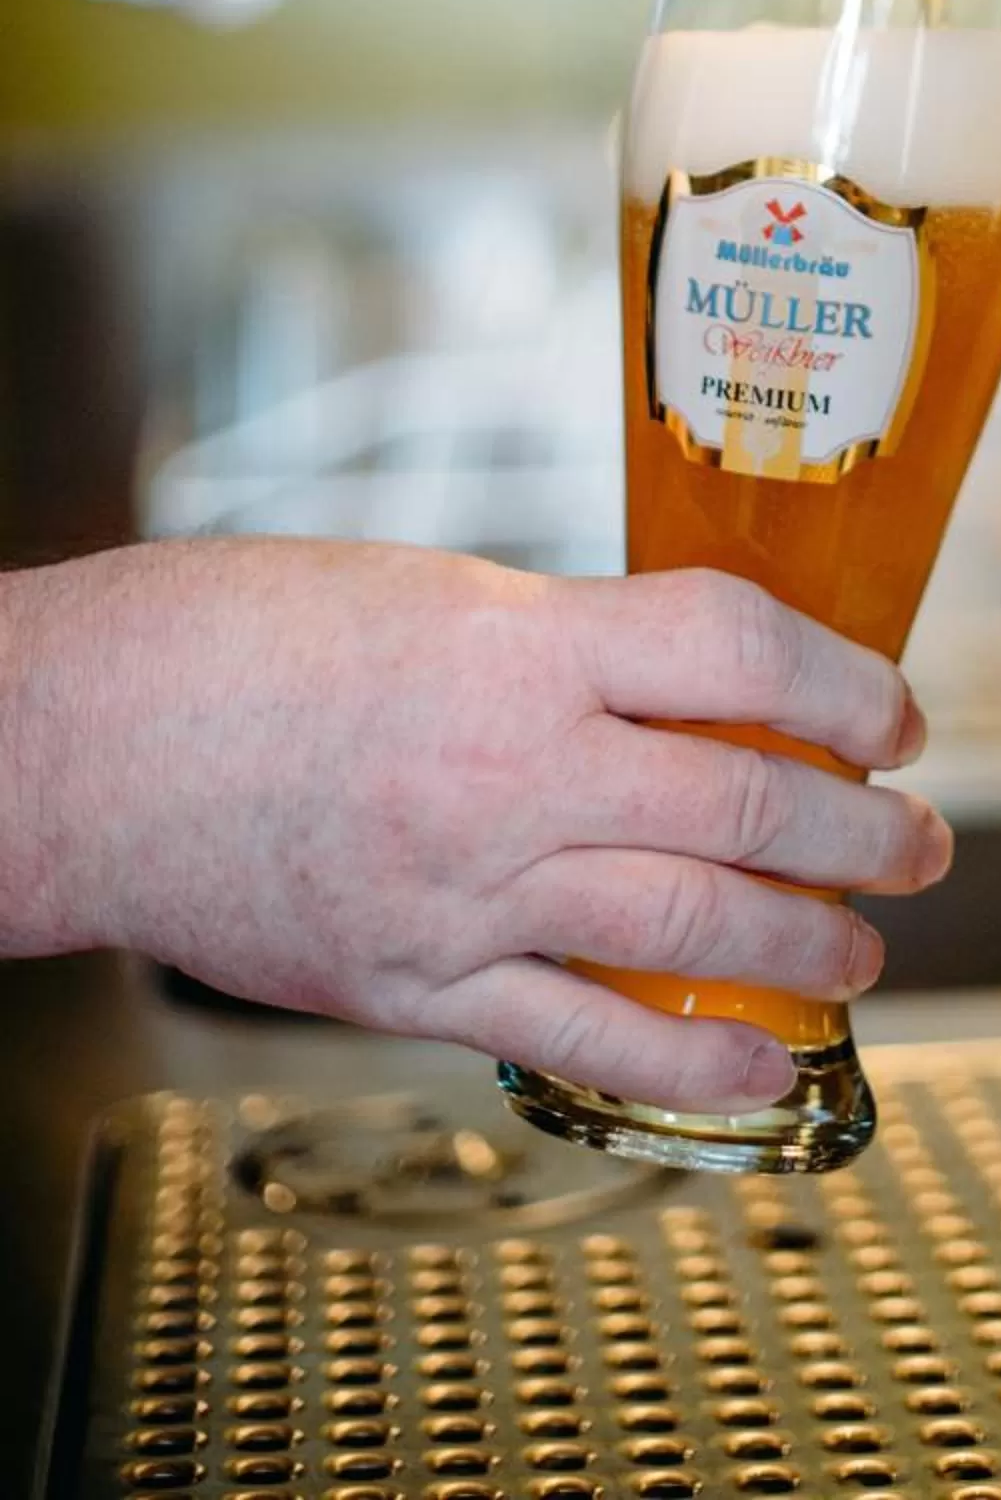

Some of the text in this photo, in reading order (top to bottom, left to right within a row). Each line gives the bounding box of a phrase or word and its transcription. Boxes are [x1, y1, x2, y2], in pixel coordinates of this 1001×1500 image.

[714, 238, 851, 279] Müllerbräu
[685, 277, 874, 339] MÜLLER
[701, 375, 831, 415] PREMIUM
